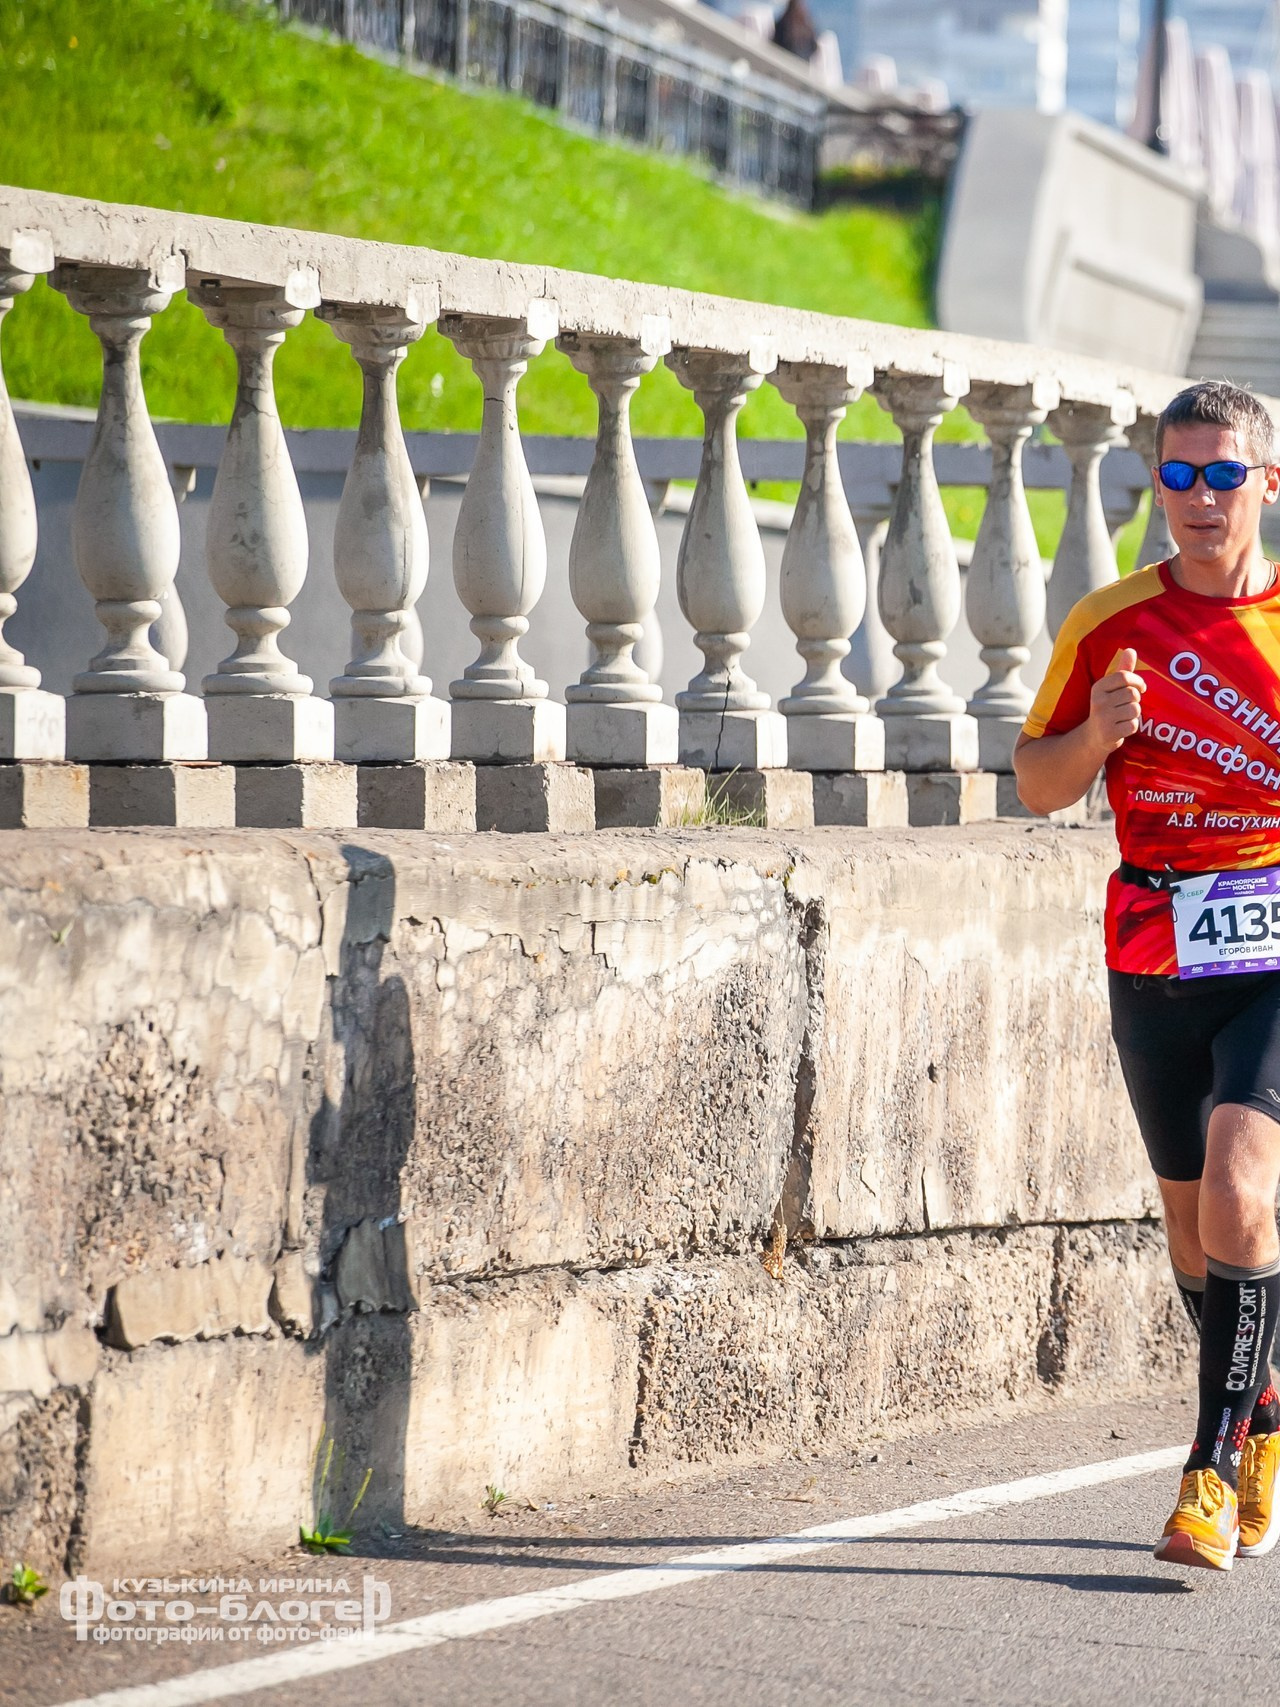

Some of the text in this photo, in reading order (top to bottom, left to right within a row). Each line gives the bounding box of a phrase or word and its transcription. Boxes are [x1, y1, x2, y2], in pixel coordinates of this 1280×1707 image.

[1135, 789, 1195, 804] памяти
[1166, 811, 1198, 828] А.В.
[1186, 889, 1204, 898] СБЕР
[1218, 944, 1274, 956] ЕГОРОВ ИВАН
